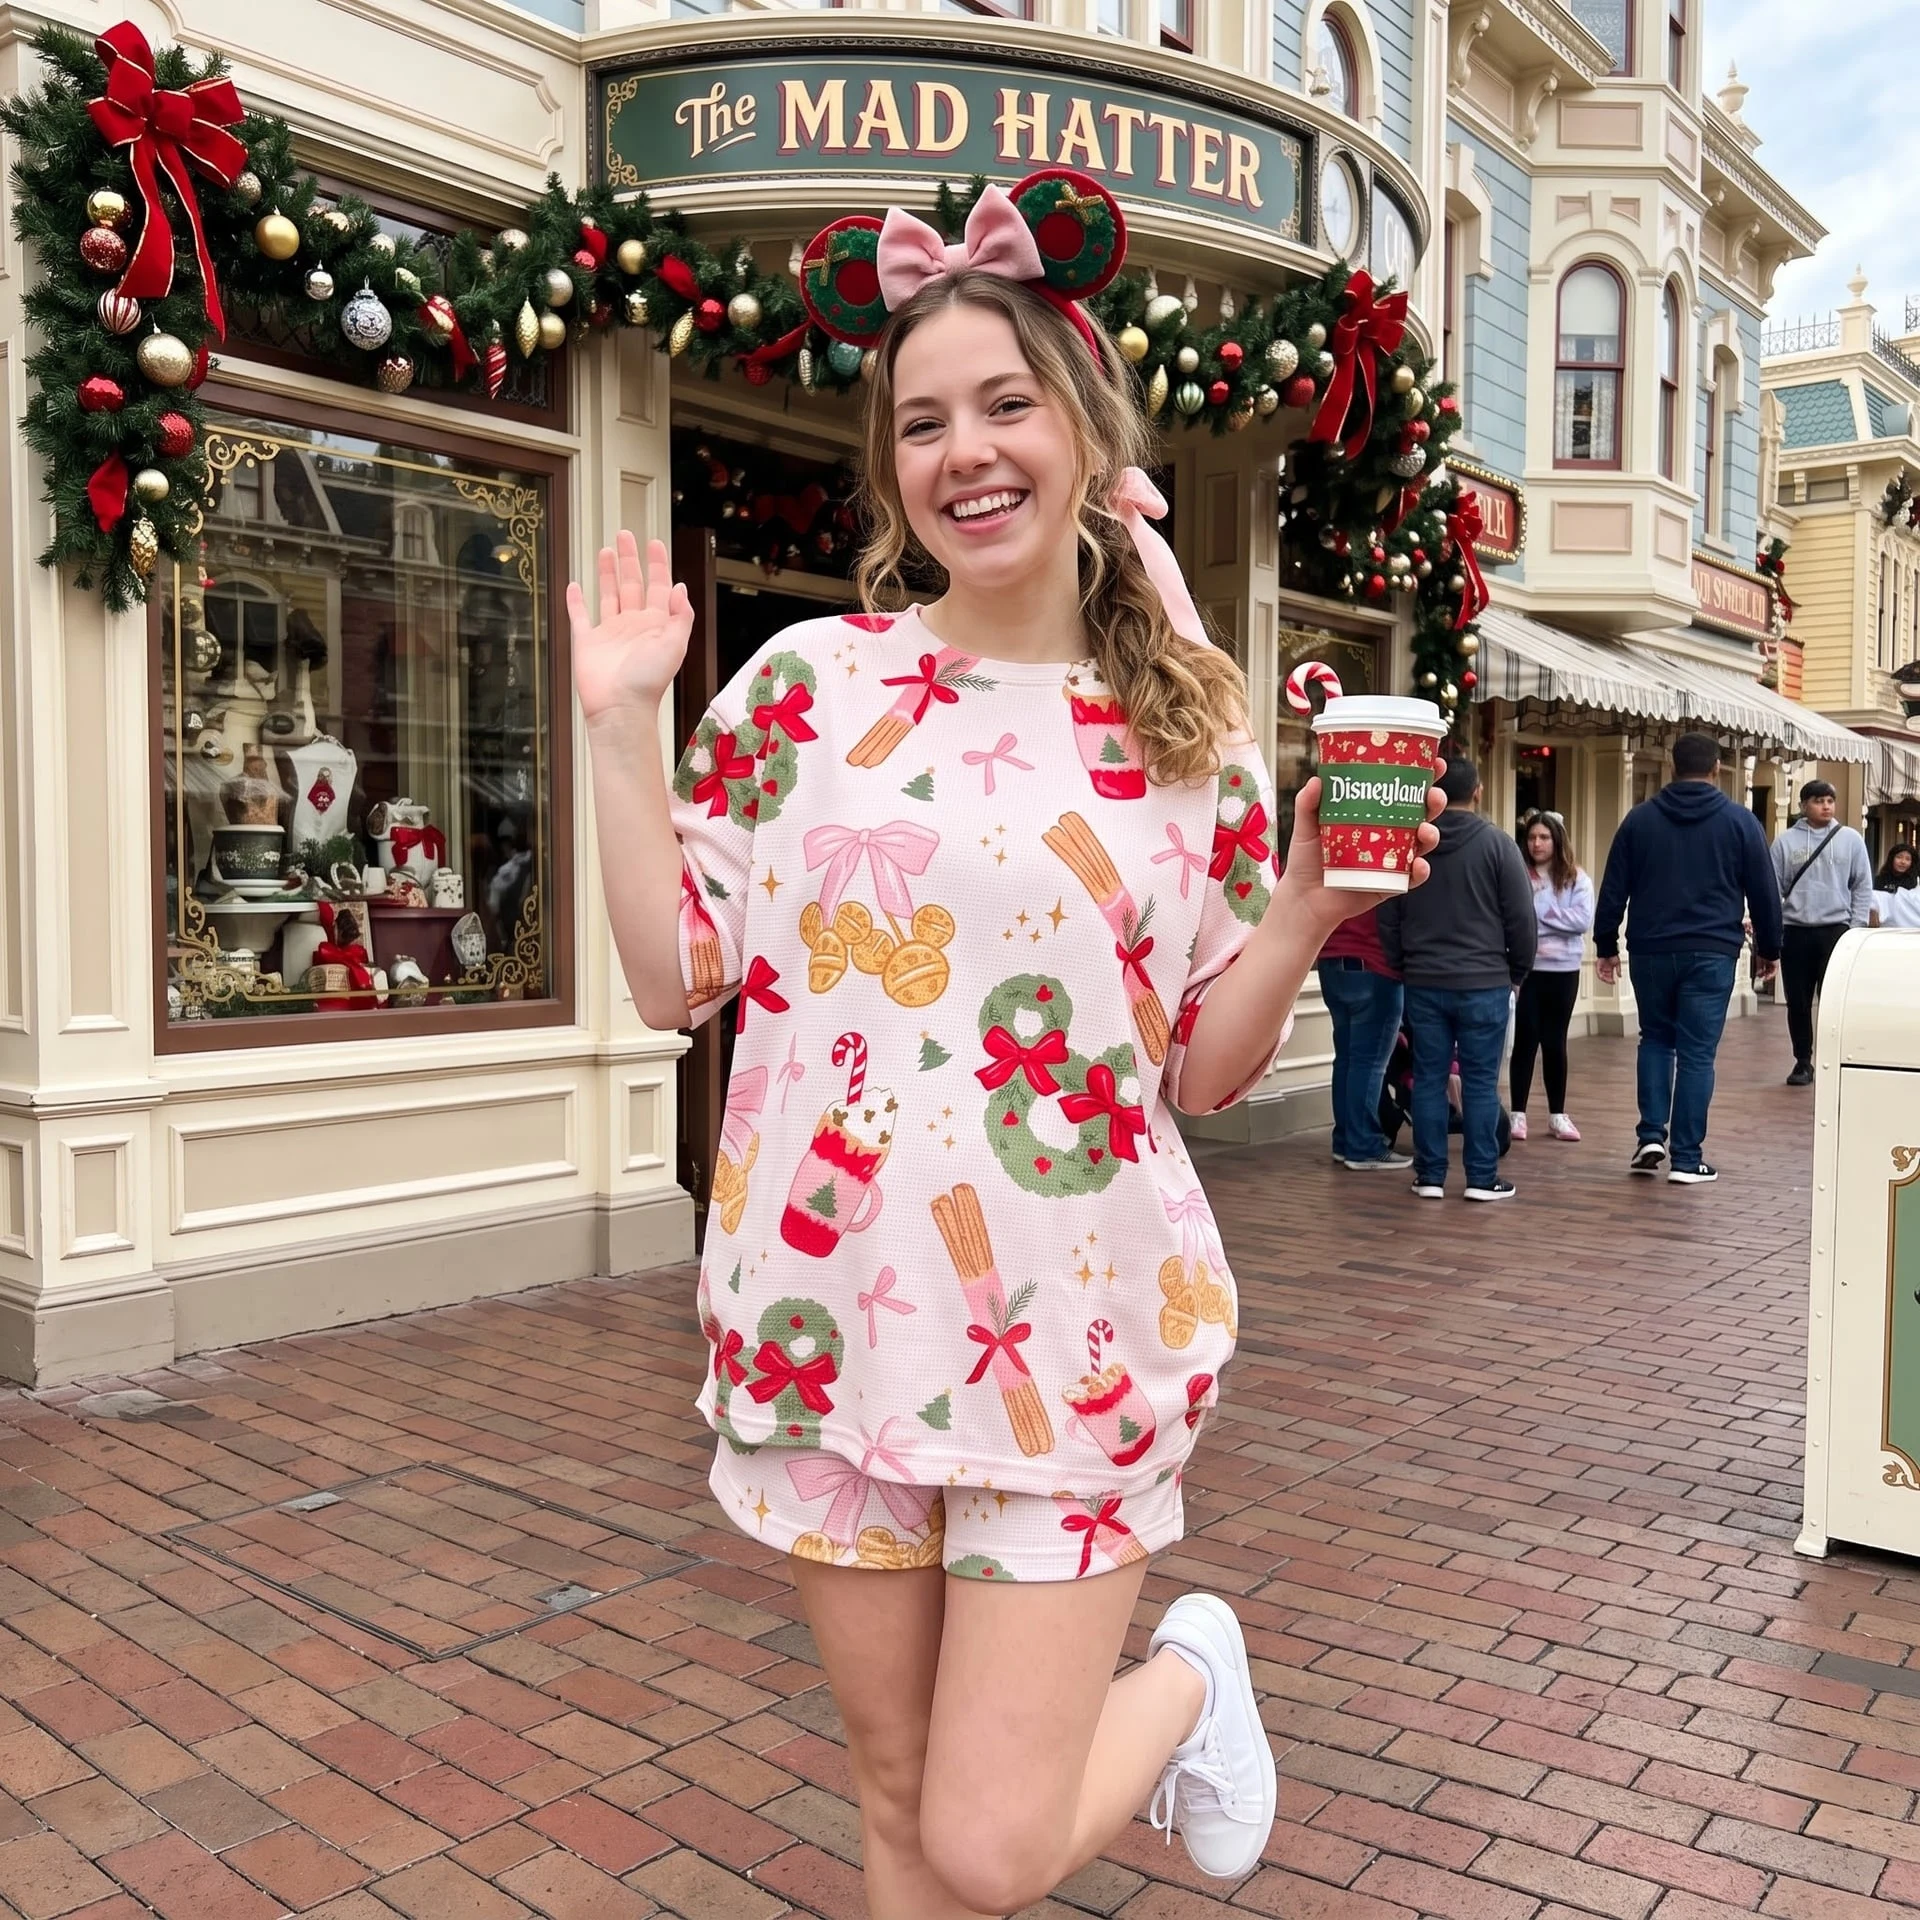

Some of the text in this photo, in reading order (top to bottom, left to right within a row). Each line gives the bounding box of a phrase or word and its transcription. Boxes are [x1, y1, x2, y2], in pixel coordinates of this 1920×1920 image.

[674, 79, 1265, 213] The MAD HATTER
[1329, 775, 1426, 807] Disneyland
